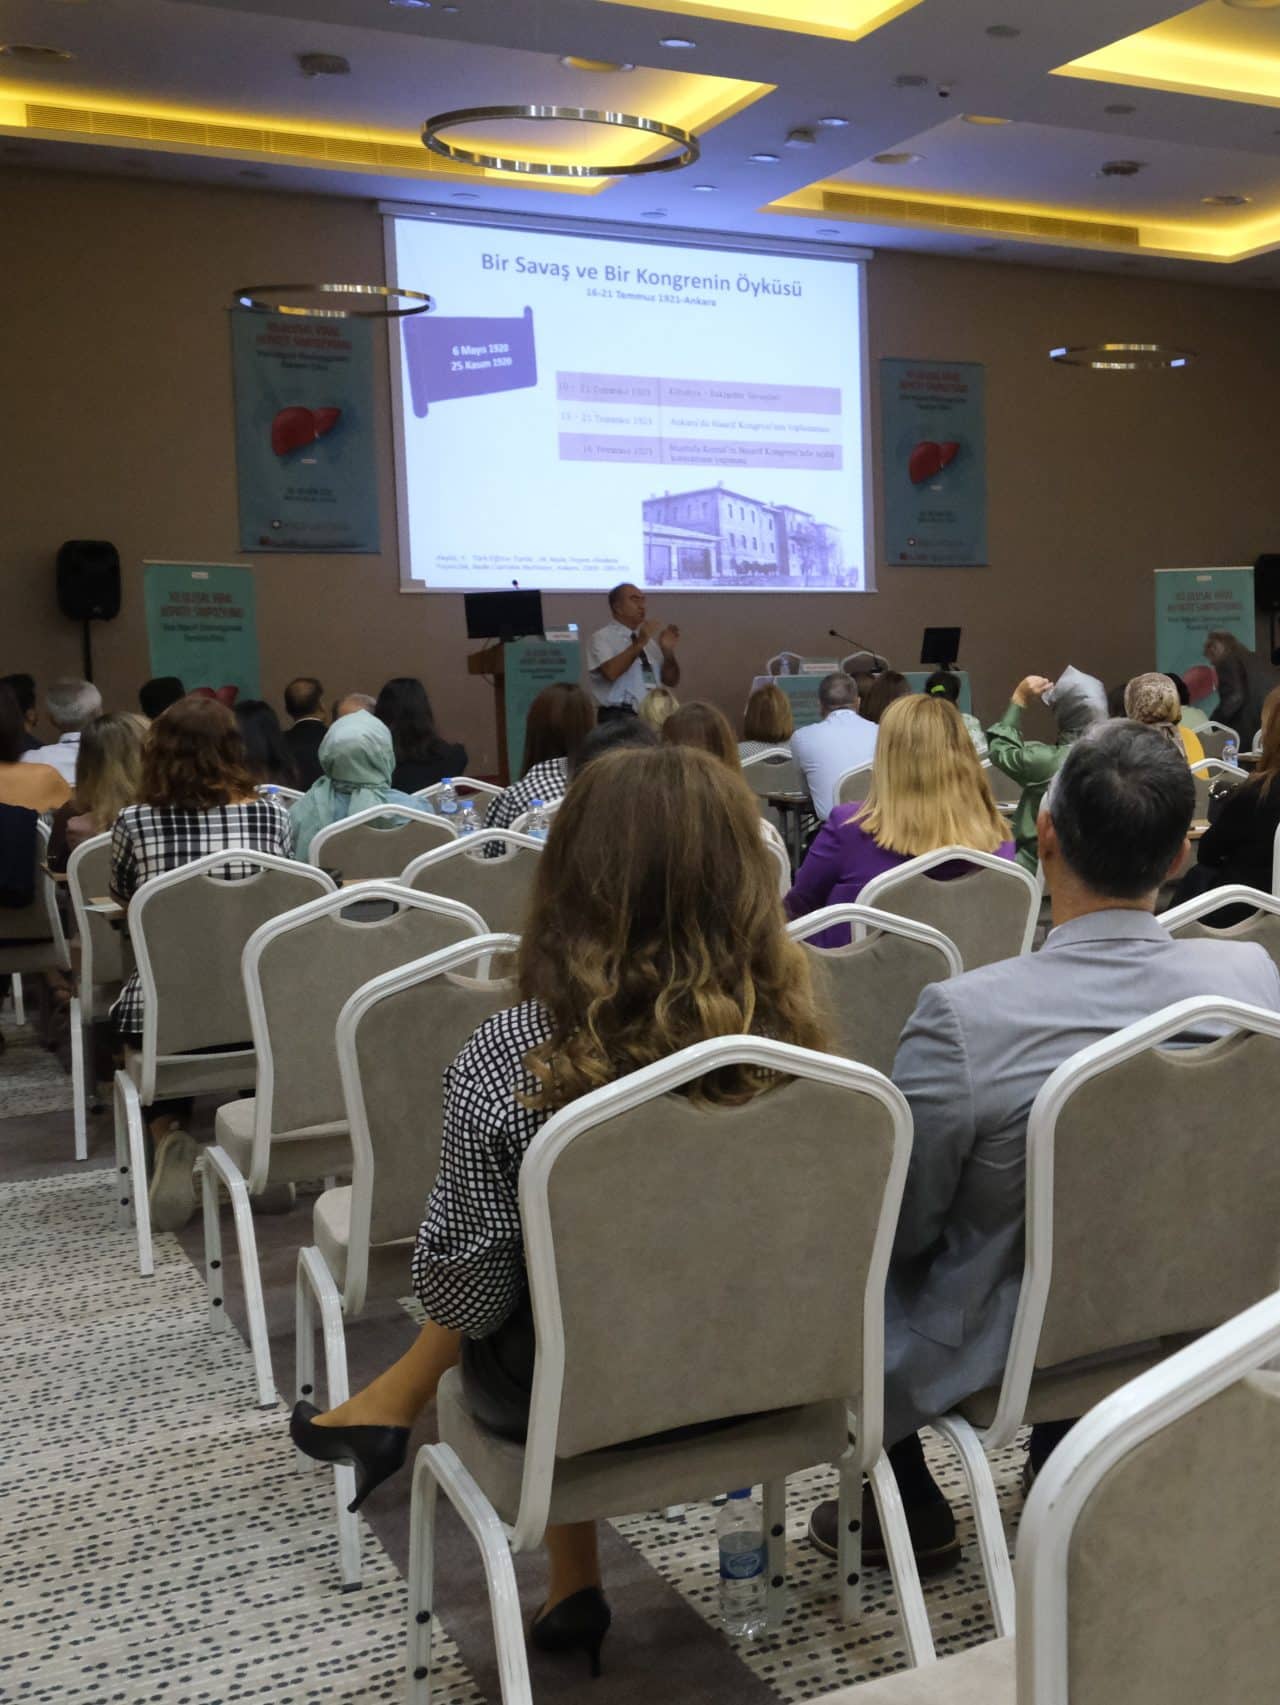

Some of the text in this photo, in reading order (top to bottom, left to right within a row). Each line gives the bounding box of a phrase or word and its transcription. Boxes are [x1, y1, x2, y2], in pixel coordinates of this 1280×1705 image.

[482, 253, 803, 298] Bir Savaş ve Bir Kongrenin Öyküsü
